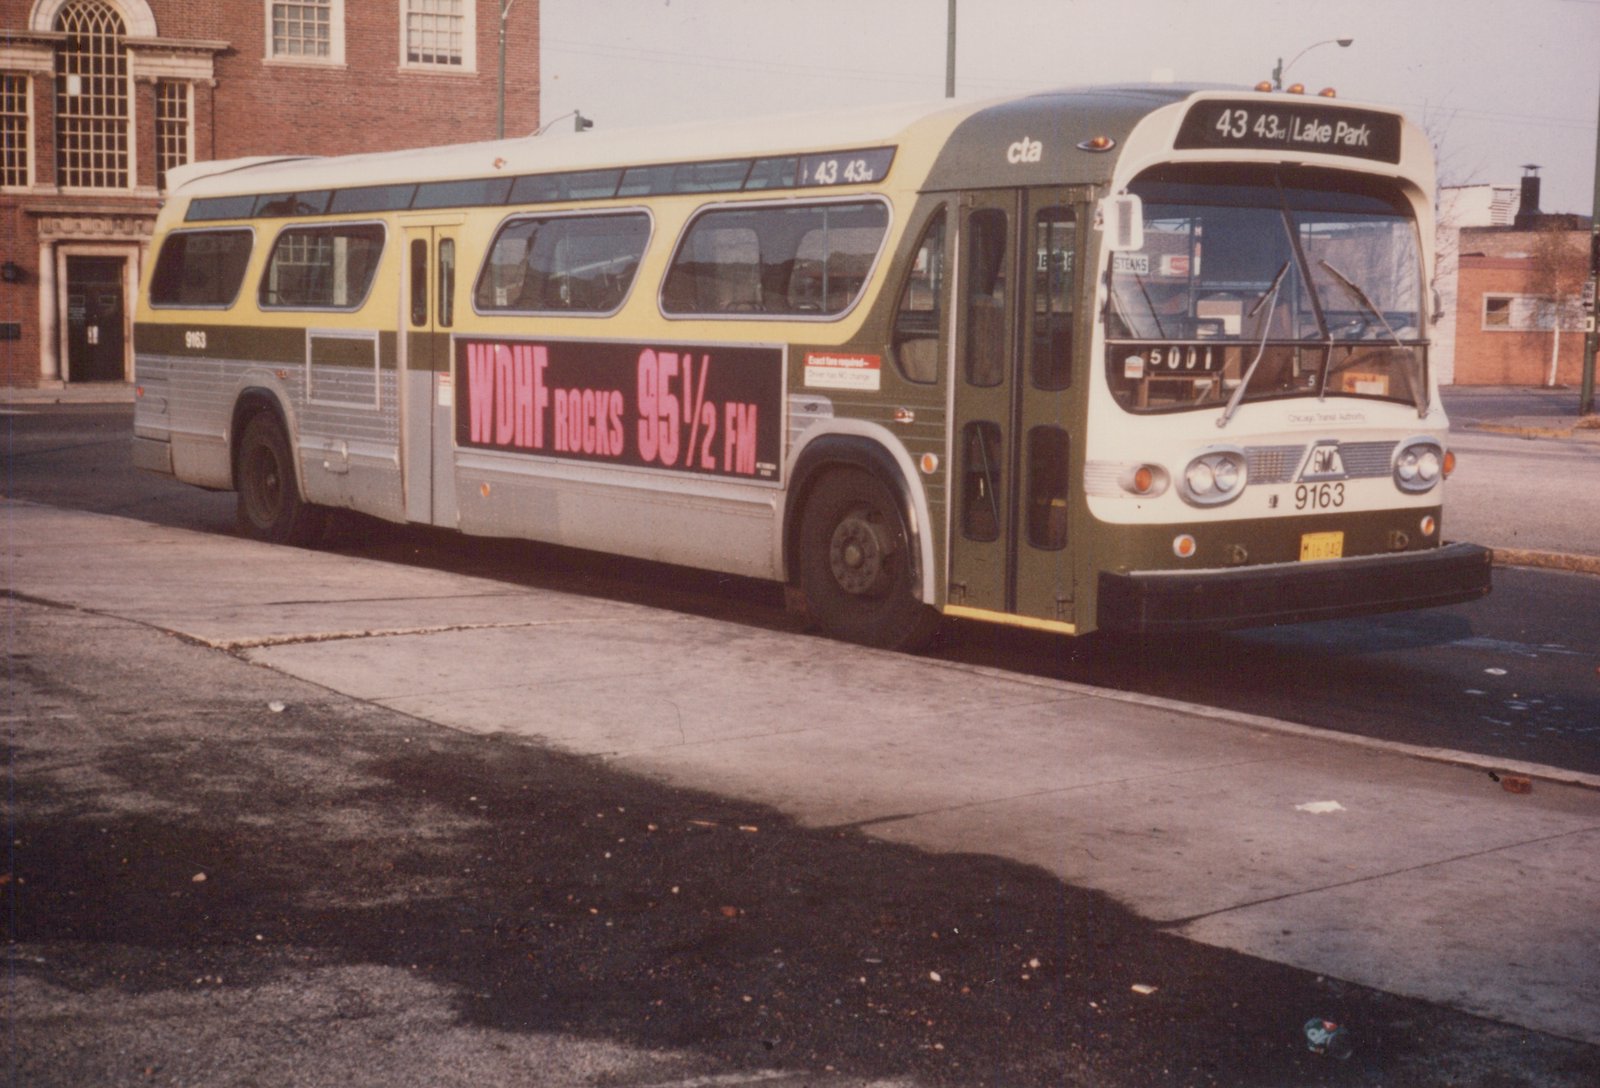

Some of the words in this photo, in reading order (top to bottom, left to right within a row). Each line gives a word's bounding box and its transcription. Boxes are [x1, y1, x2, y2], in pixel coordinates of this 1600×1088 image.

[1216, 108, 1248, 138] 43
[1253, 114, 1286, 139] 43rd
[1293, 117, 1332, 142] Lake
[1334, 121, 1371, 146] Park
[1007, 136, 1043, 164] cta
[814, 160, 838, 184] 43
[1114, 256, 1147, 271] STEAKS
[185, 331, 206, 349] 9163
[467, 343, 548, 448] WDHF
[554, 388, 624, 456] ROCKS
[724, 402, 757, 474] FM
[1314, 449, 1339, 473] GMC
[1295, 483, 1345, 510] 9163
